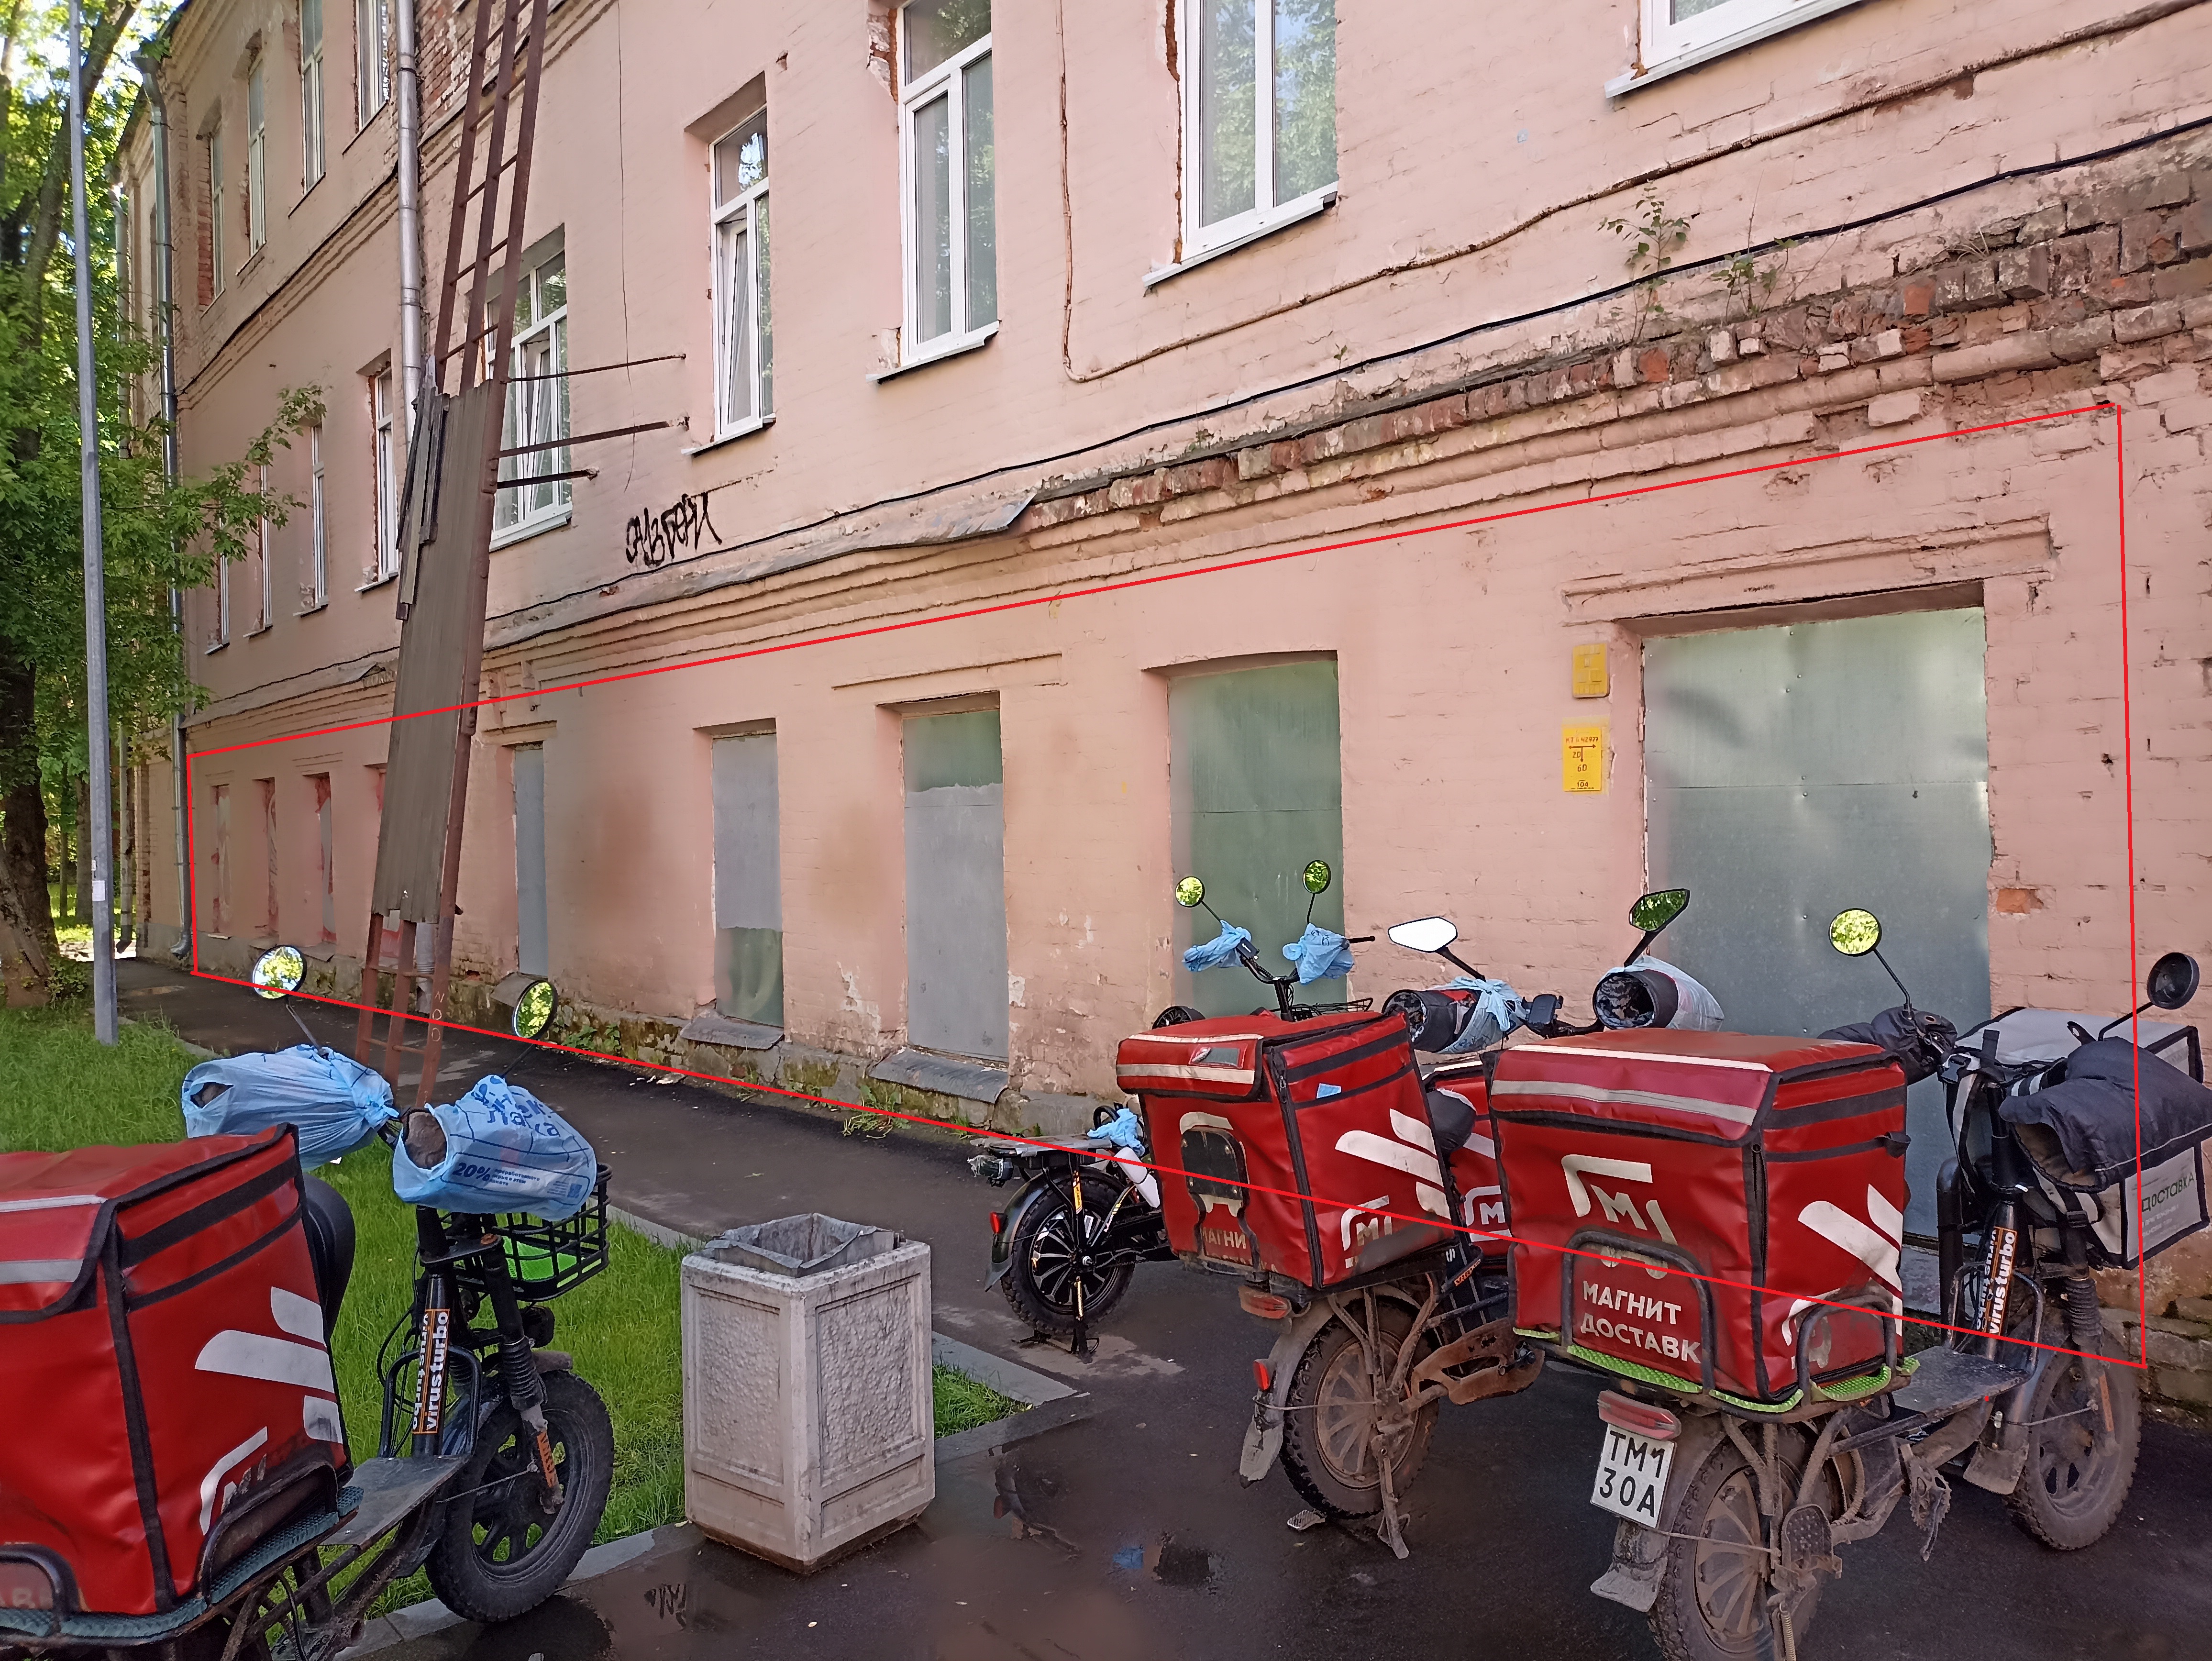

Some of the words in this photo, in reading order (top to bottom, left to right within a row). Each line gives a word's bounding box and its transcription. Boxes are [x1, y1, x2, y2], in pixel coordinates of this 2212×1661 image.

[452, 1162, 491, 1182] 20%
[1582, 1280, 1681, 1325] МАГНИТ
[1580, 1312, 1701, 1364] ДОСТАВК
